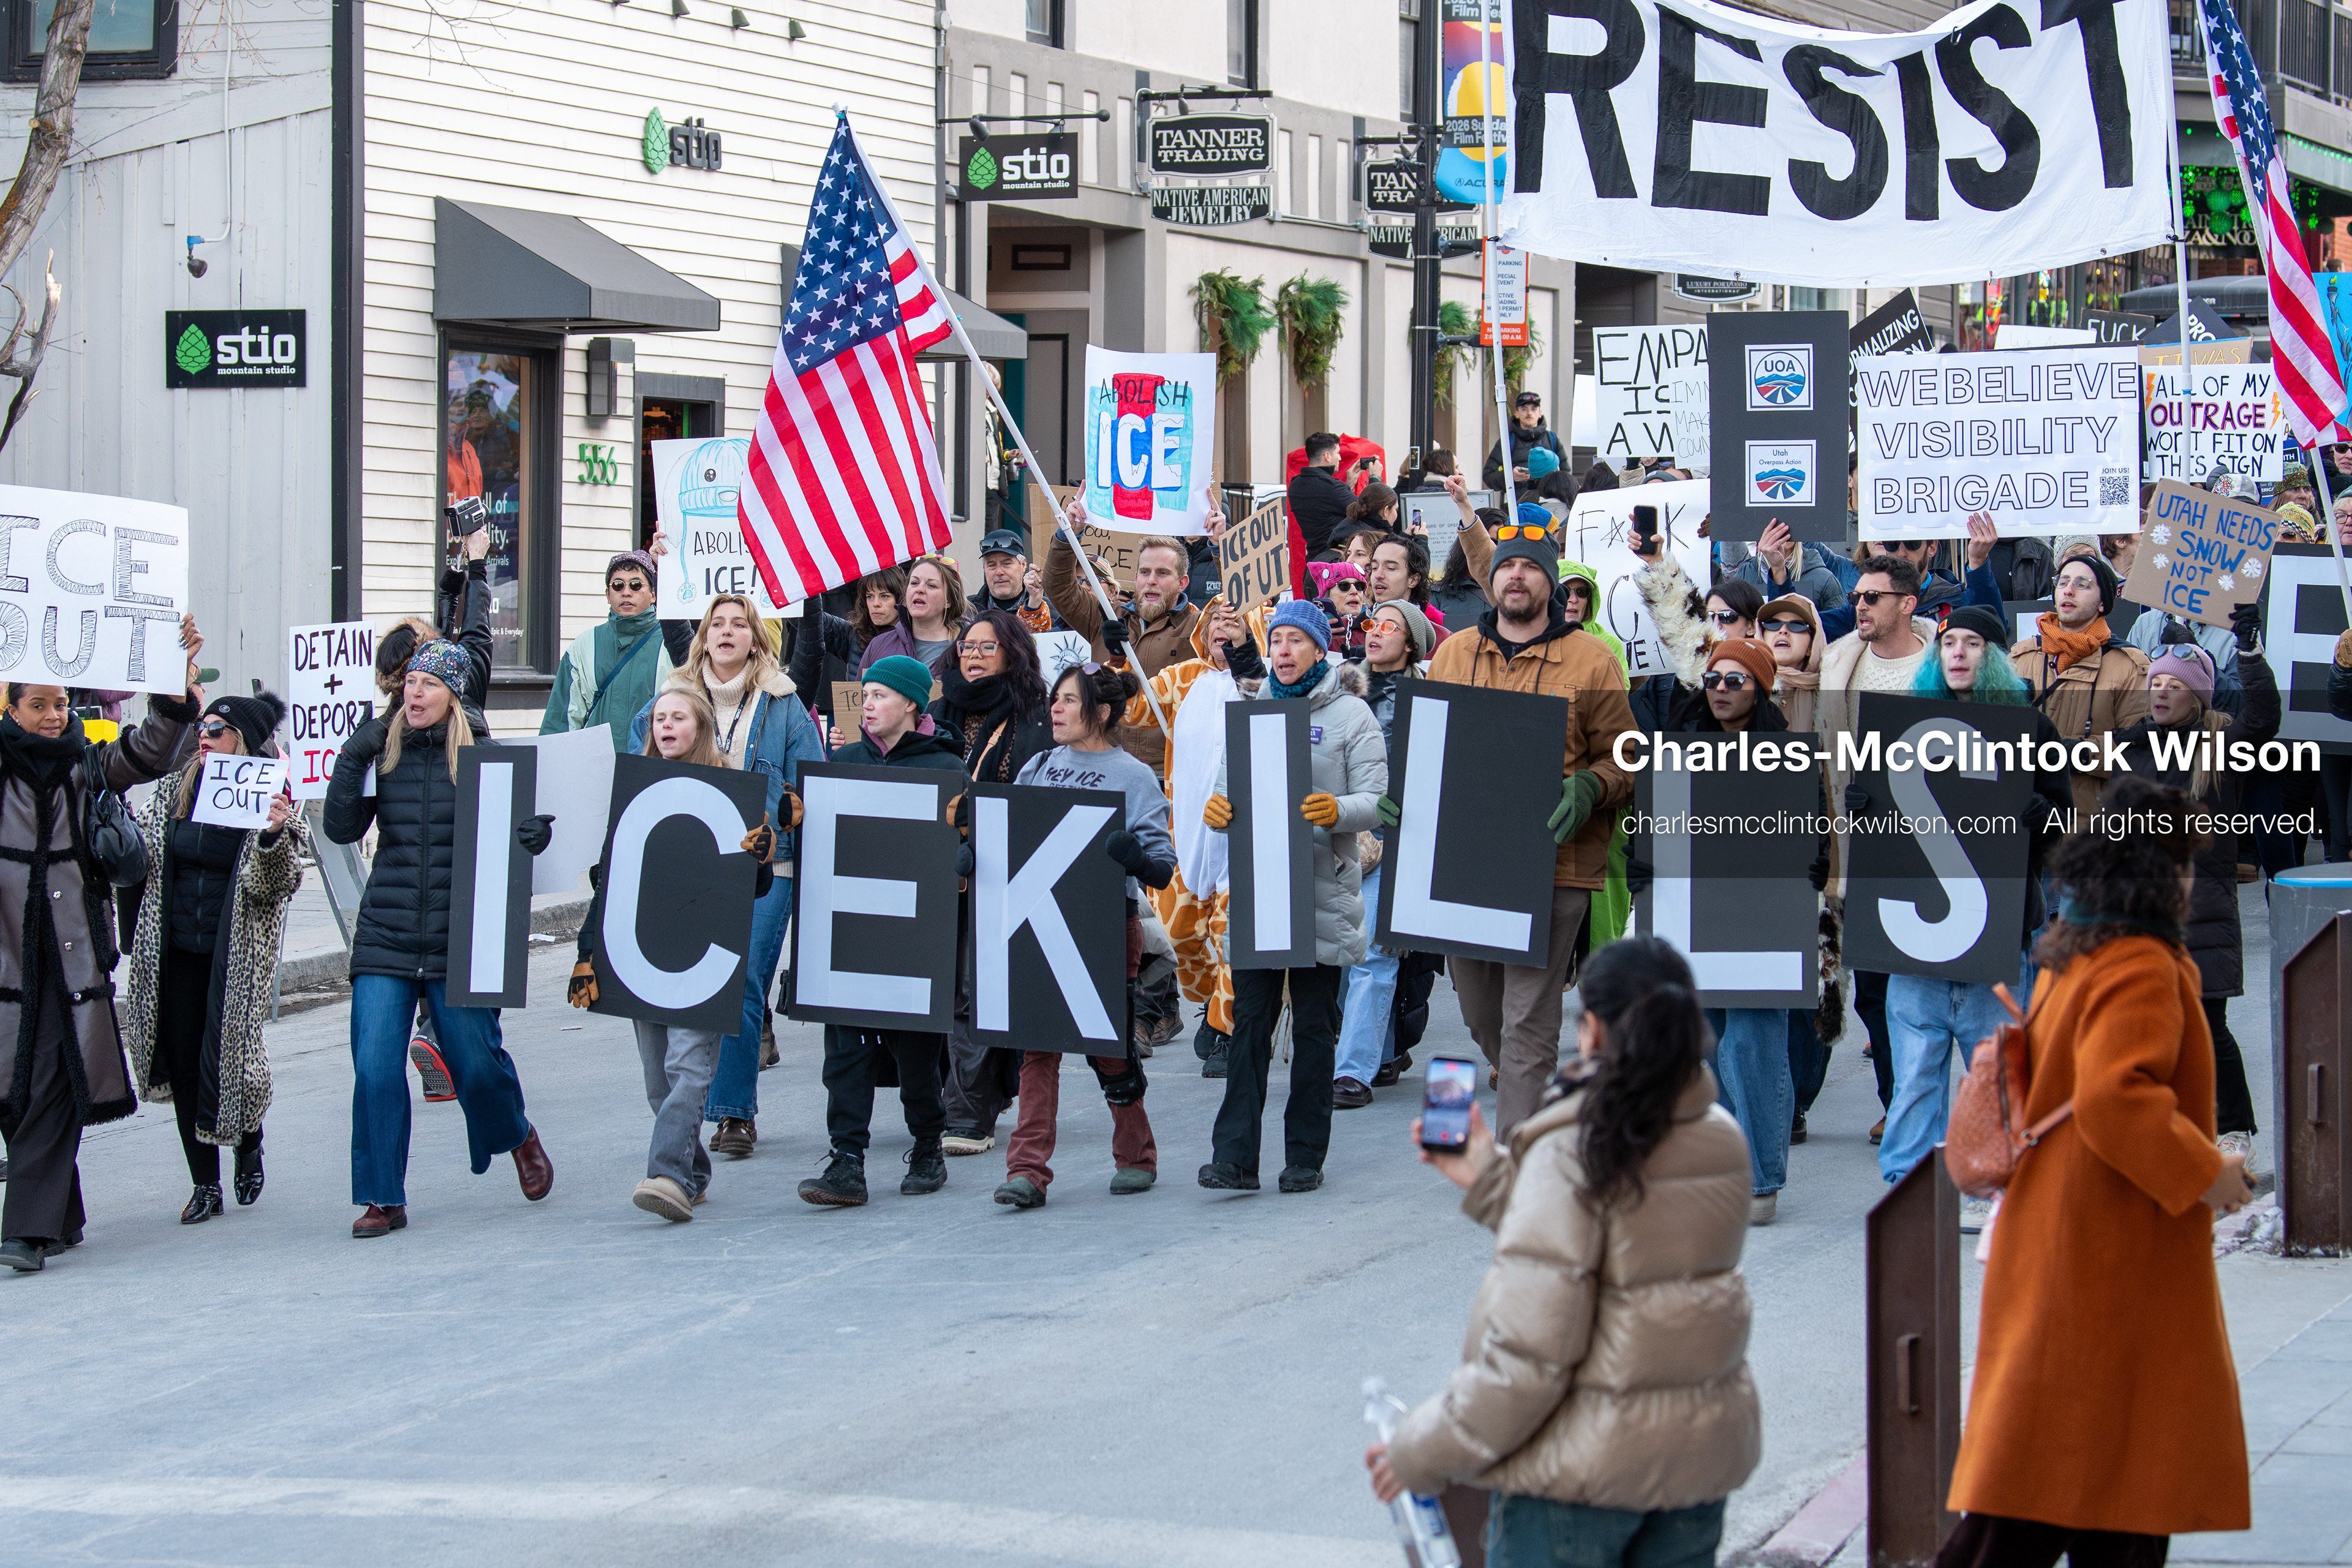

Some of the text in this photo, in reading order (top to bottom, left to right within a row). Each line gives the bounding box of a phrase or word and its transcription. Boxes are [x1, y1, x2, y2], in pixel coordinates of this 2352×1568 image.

[1452, 4, 1479, 17] Film
[1513, 0, 2134, 221] RESIST
[1156, 127, 1265, 149] TANNER
[1446, 119, 1470, 132] 2026
[1453, 131, 1474, 144] Film
[669, 116, 722, 170] stio
[1158, 148, 1265, 162] TRADING
[1002, 146, 1070, 181] stio
[1043, 180, 1070, 189] studio
[1153, 187, 1268, 207] NATIVE AMERICAN
[1167, 205, 1253, 225] JEWELRY
[1370, 227, 1412, 243] NATIVE
[2087, 318, 2147, 343] FUCK
[217, 325, 296, 364] stio
[1597, 328, 1709, 386] EMPA
[265, 365, 296, 374] studio
[1764, 360, 1796, 372] UOA
[1099, 377, 1189, 407] ABOLISH
[2203, 375, 2230, 397] OF
[2241, 372, 2271, 398] MY
[2150, 400, 2266, 431] OUTRAGE
[1872, 416, 2118, 459] VISIBILITY
[2212, 432, 2248, 453] FIT
[2252, 432, 2277, 454] ON
[579, 443, 618, 485] 556
[1097, 411, 1186, 491] ICE
[2215, 454, 2264, 478] SIGN
[496, 492, 508, 514] of
[1874, 471, 2089, 514] BRIGADE
[2157, 492, 2277, 551] UTAH NEEDS
[1222, 505, 1279, 570] ICE OUT
[486, 554, 509, 566] Arrivals
[2176, 530, 2247, 573] SNOW
[706, 565, 758, 595] ICE!
[1228, 543, 1283, 611] OF UT
[2170, 560, 2214, 586] NOT
[2163, 580, 2211, 615] ICE
[295, 628, 372, 671] DETAIN
[209, 760, 276, 785] ICE
[302, 748, 344, 784] IC
[1044, 767, 1106, 788] HEY ICE
[212, 787, 268, 813] OUT
